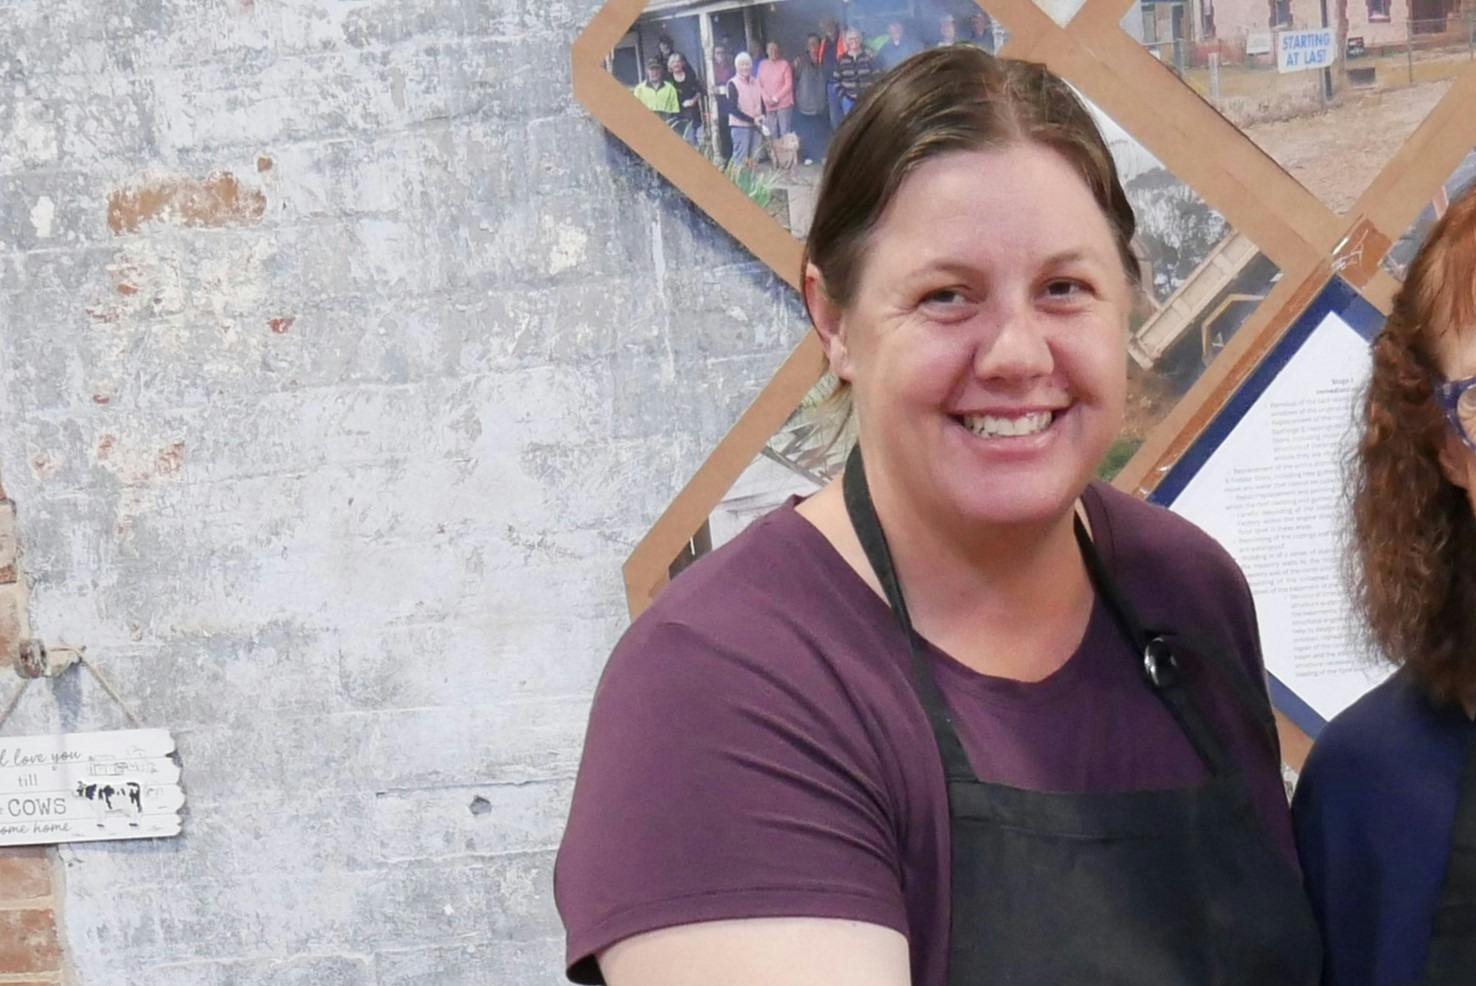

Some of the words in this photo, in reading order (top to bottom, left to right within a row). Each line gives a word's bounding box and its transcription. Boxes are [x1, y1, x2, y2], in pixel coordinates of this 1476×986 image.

[1282, 31, 1330, 51] STARTING
[1285, 53, 1299, 67] AT
[1304, 50, 1327, 64] LAST
[14, 748, 47, 767] love
[51, 751, 81, 771] you
[18, 773, 38, 787] till
[8, 797, 66, 817] COWS
[33, 820, 72, 834] home
